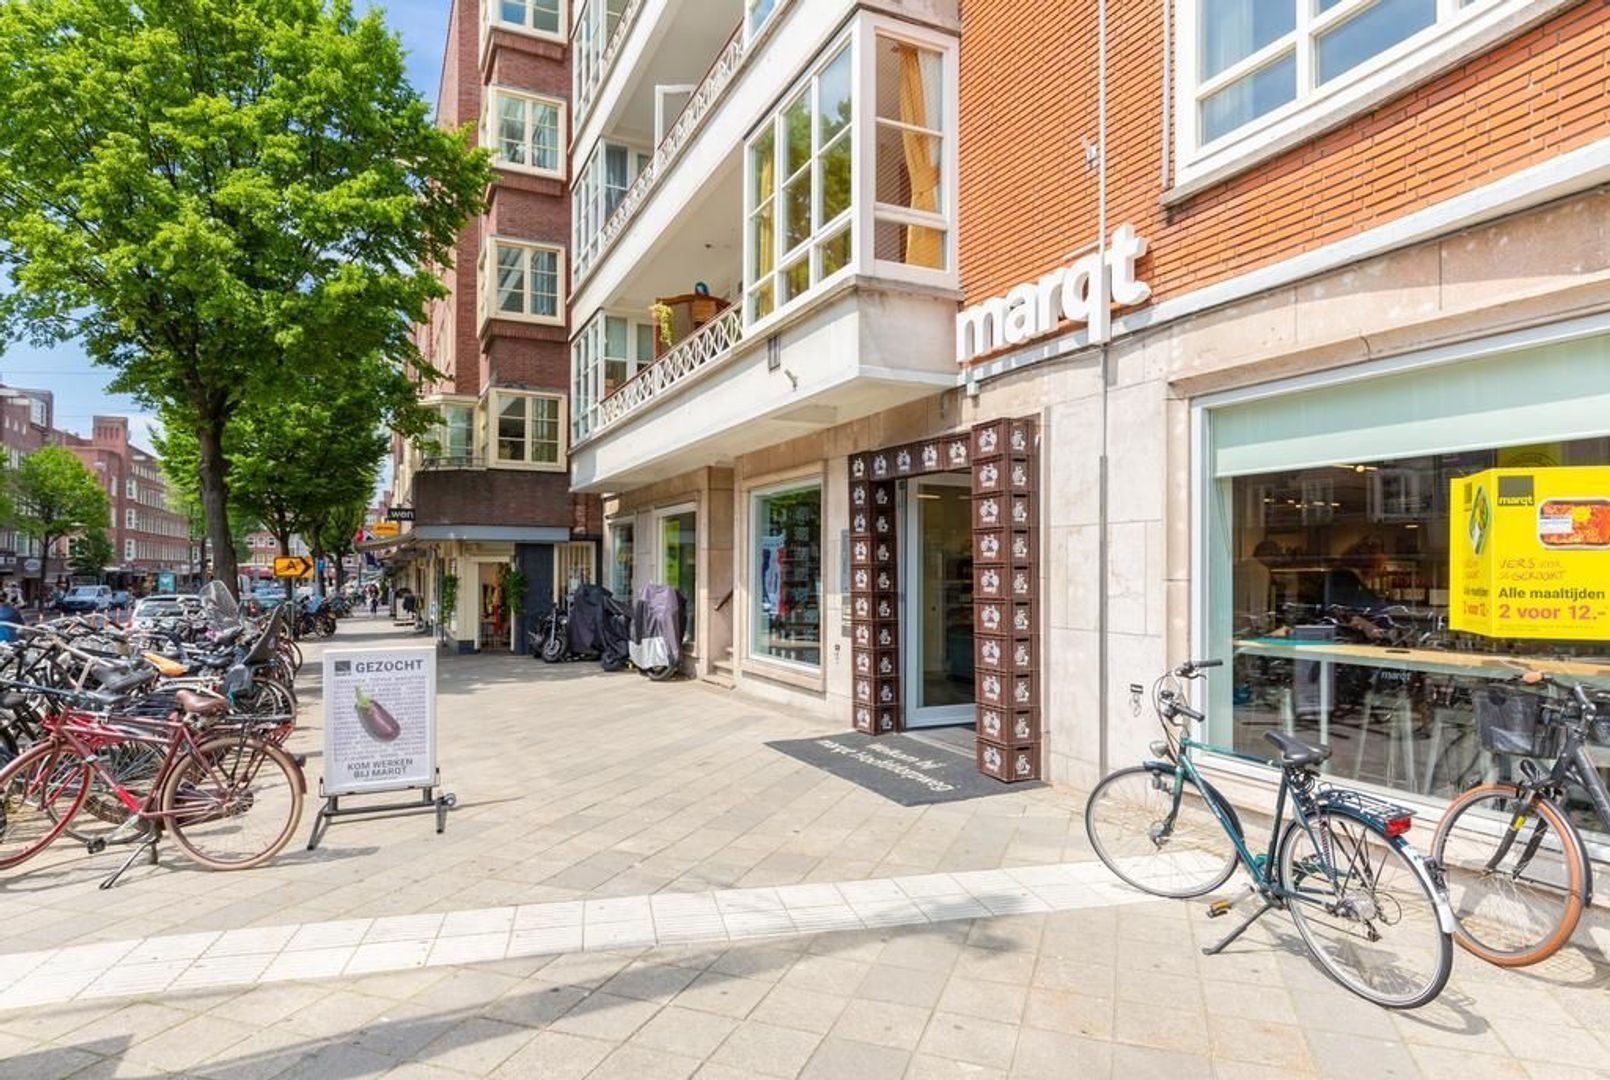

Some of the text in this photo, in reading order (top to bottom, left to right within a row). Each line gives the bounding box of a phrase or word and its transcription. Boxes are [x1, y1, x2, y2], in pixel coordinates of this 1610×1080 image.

[956, 222, 1152, 363] marqt
[1499, 494, 1533, 506] marqt
[1499, 587, 1526, 599] Alle
[1530, 588, 1605, 602] maaltijden
[1499, 603, 1511, 619] 2
[1517, 607, 1561, 619] voor
[1568, 605, 1606, 620] 12.-
[355, 659, 424, 673] GEZOCHT
[347, 758, 413, 771] KOM WERKEN
[371, 766, 407, 776] MARQT
